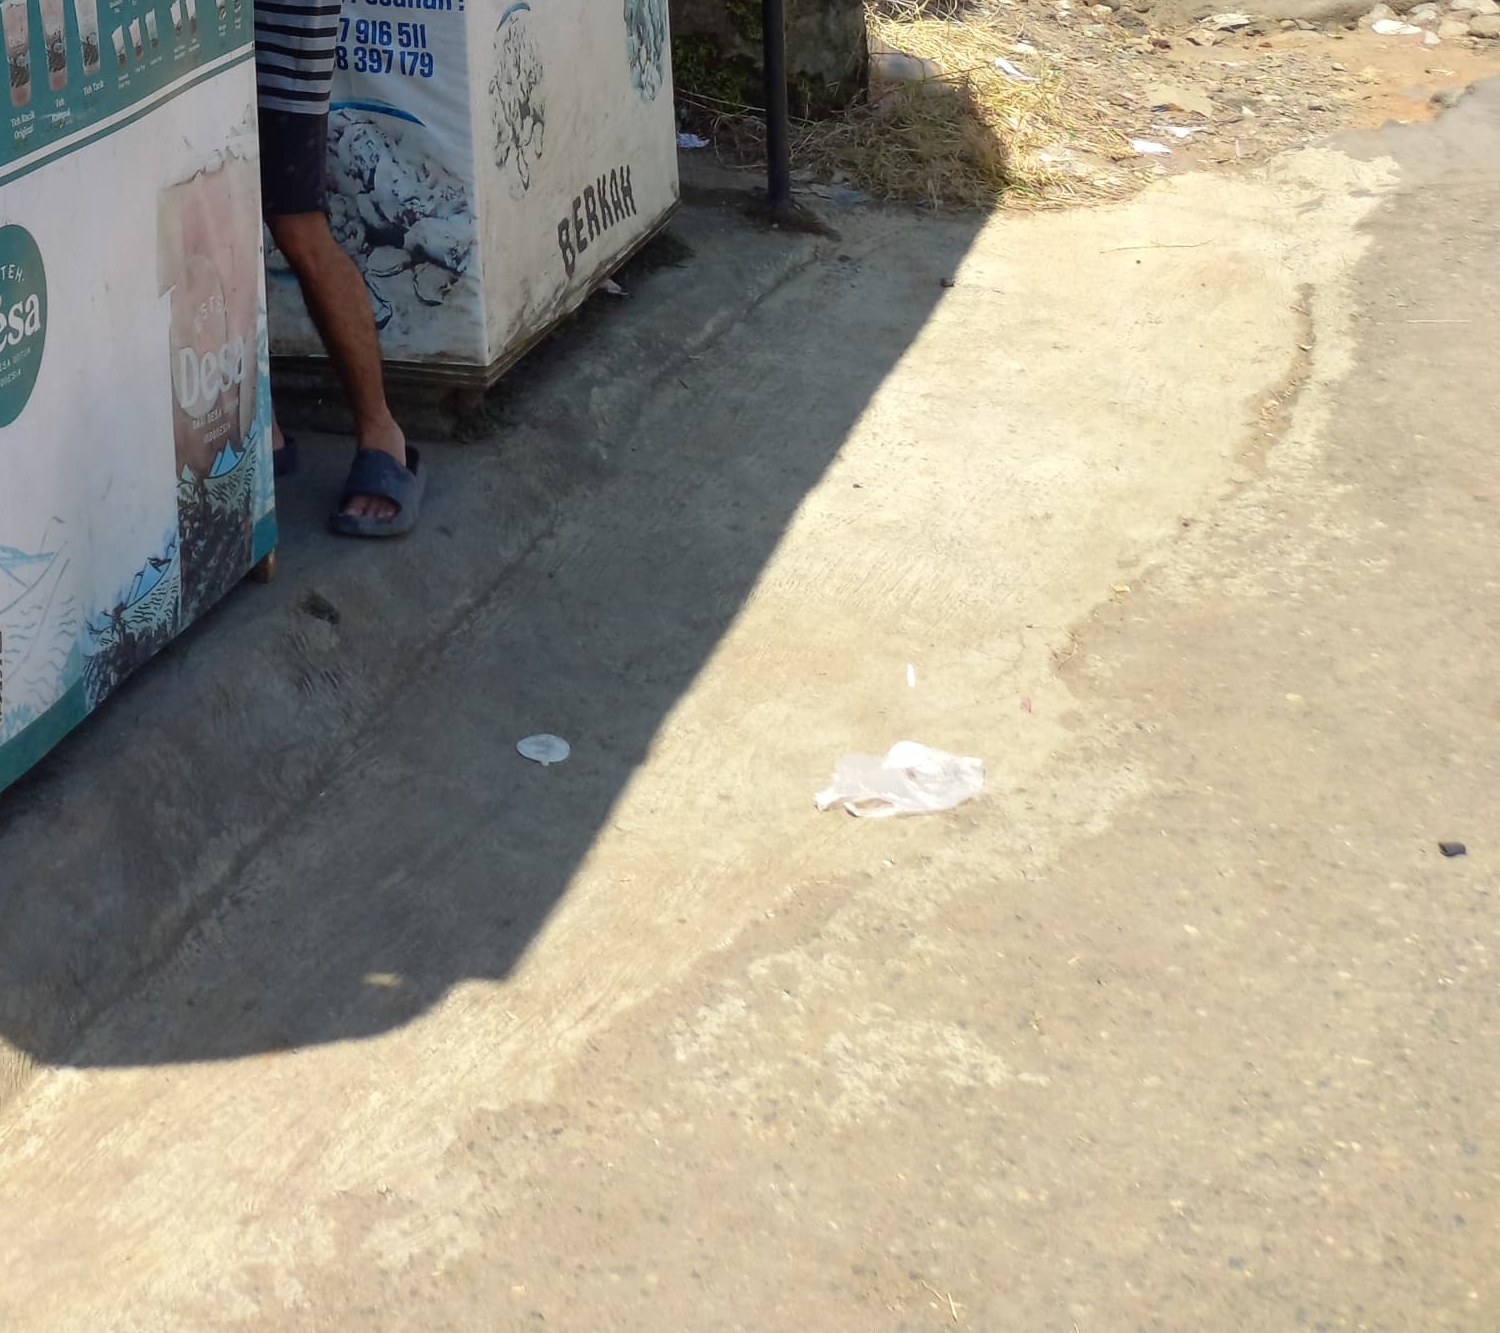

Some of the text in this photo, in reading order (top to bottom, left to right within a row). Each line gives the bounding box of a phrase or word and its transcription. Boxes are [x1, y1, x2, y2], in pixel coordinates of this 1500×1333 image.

[355, 19, 393, 46] 916
[397, 21, 427, 49] 511
[353, 46, 394, 74] 397
[399, 50, 434, 78] 179
[557, 164, 637, 279] BERKAH
[179, 334, 245, 409] Desa
